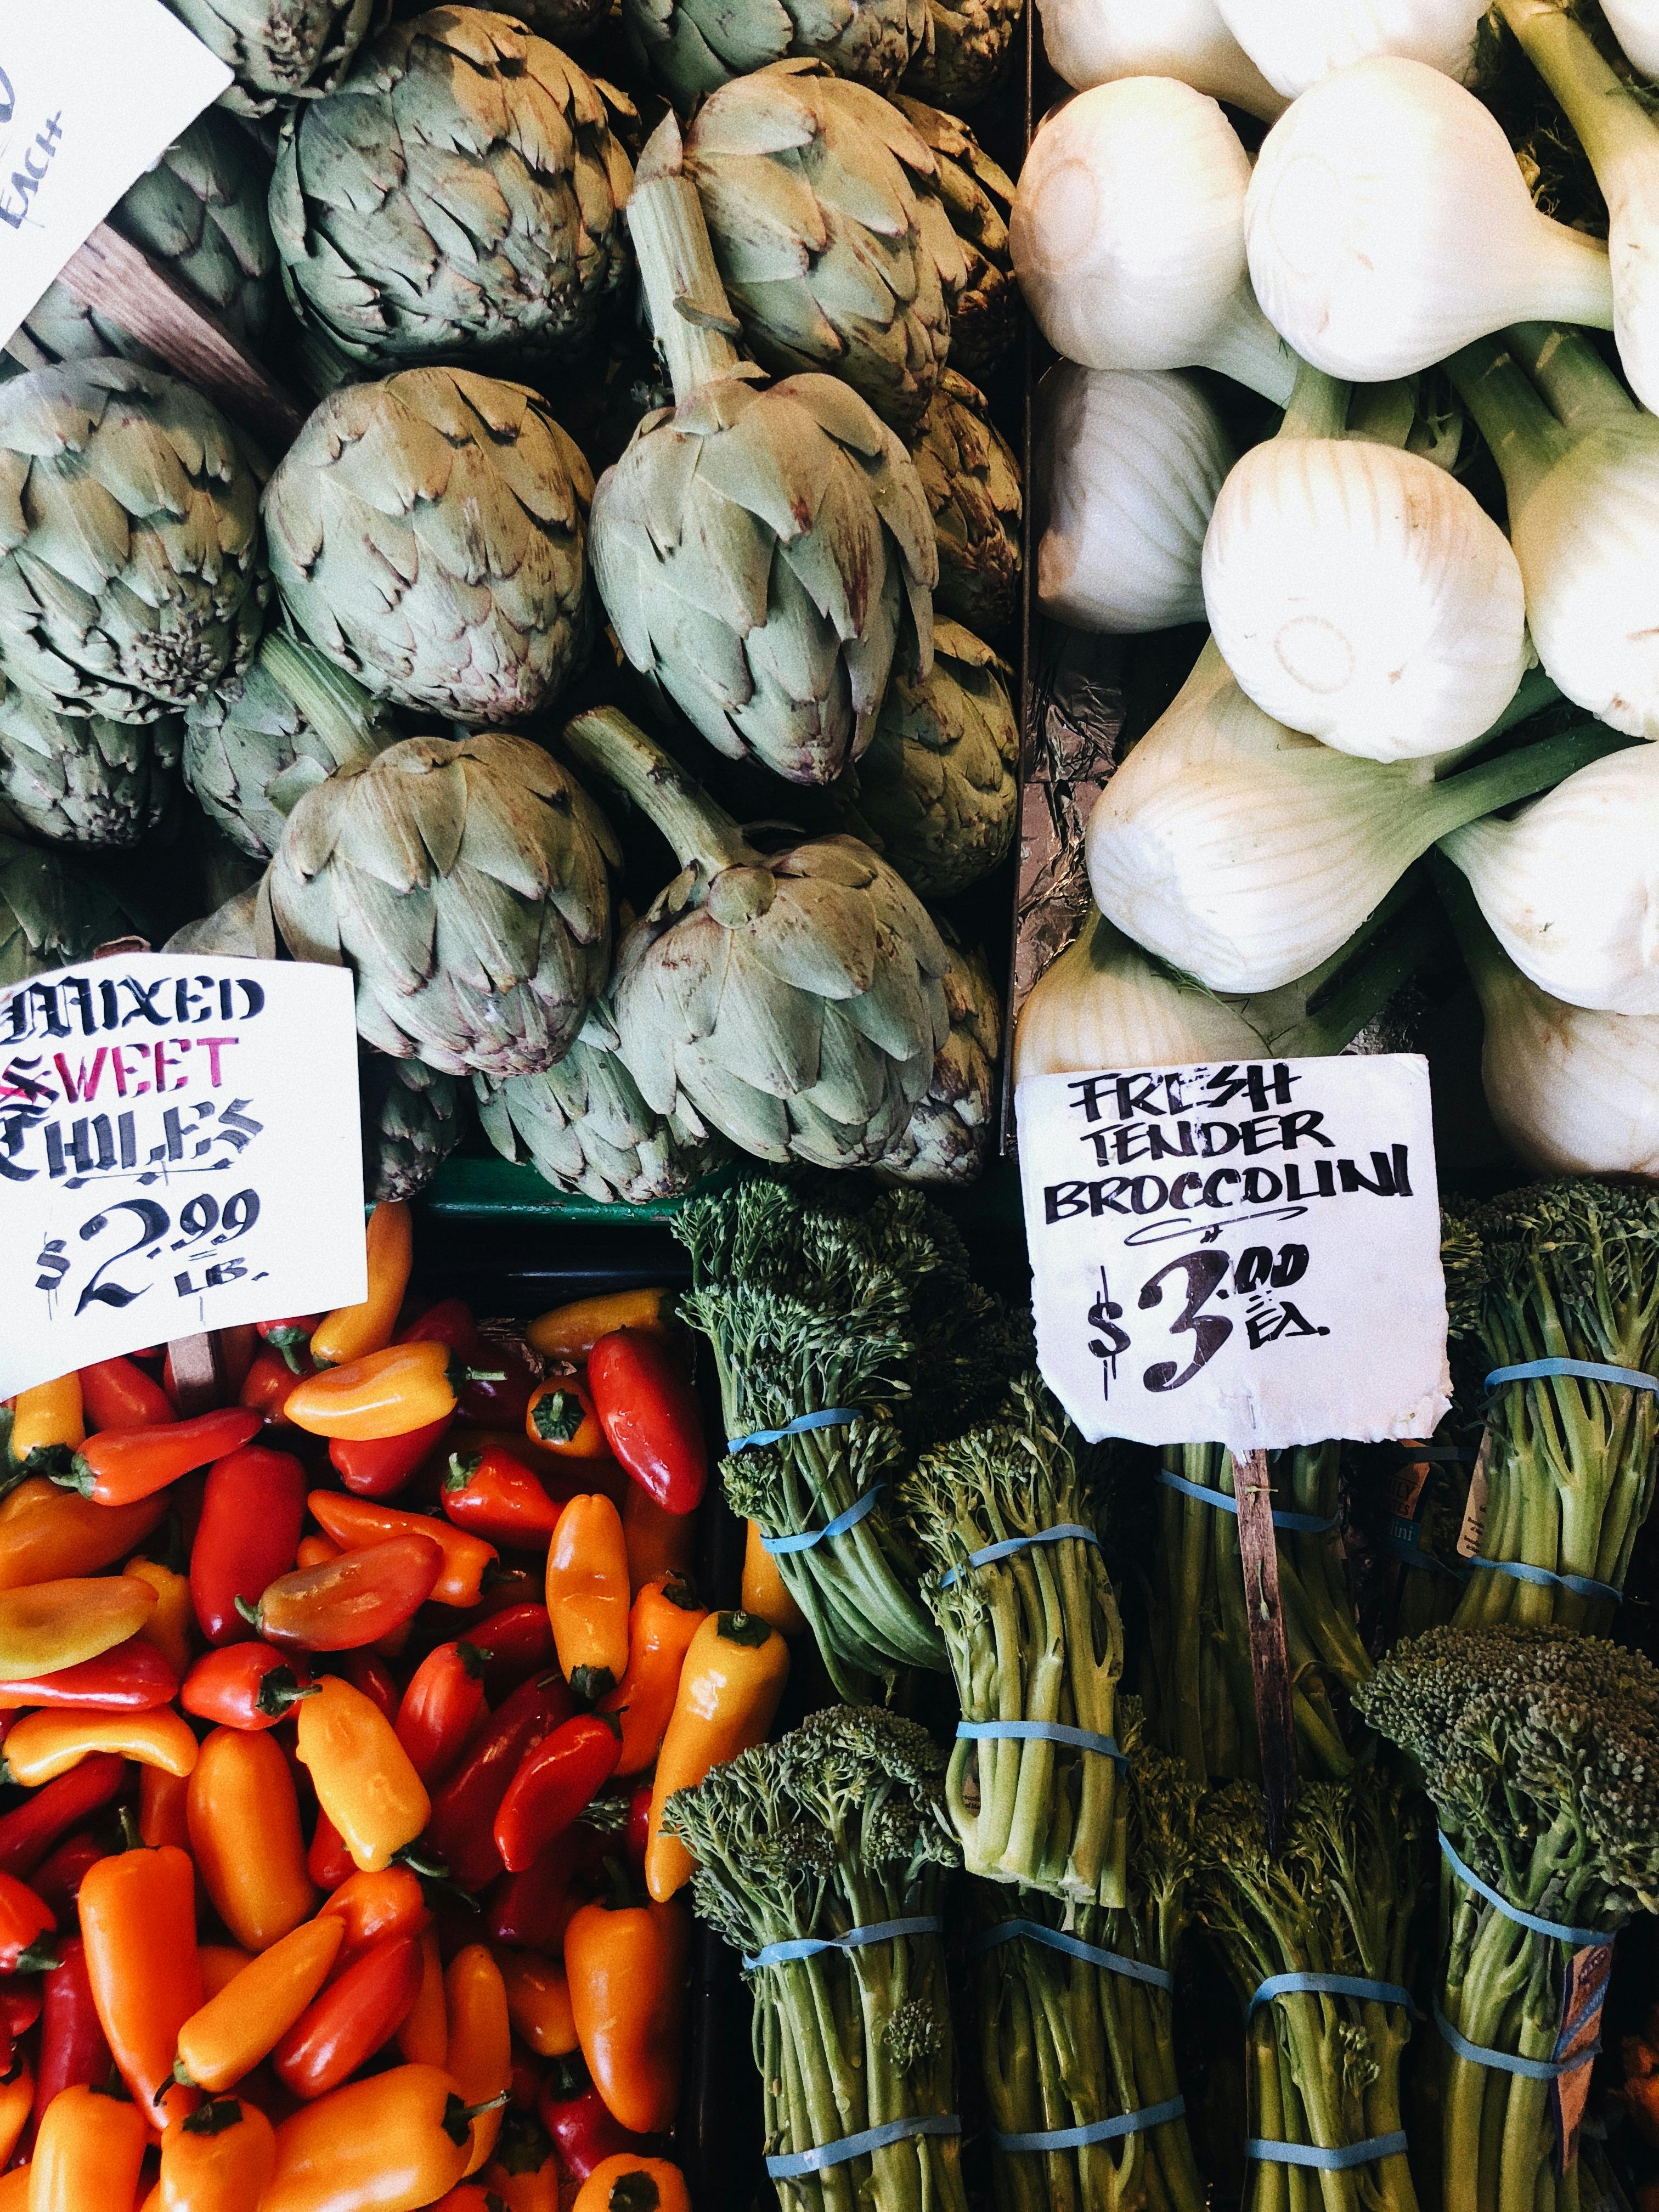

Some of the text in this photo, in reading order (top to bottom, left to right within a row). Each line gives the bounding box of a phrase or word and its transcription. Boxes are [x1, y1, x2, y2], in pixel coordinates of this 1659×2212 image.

[0, 110, 62, 229] EACH
[0, 975, 266, 1045] MIXED
[0, 1036, 240, 1115] SWEET
[1068, 1062, 1302, 1122] FRESH
[0, 1098, 265, 1182] CHILES
[1080, 1109, 1336, 1167] TENDER
[1043, 1144, 1414, 1225] BROCCOLINI
